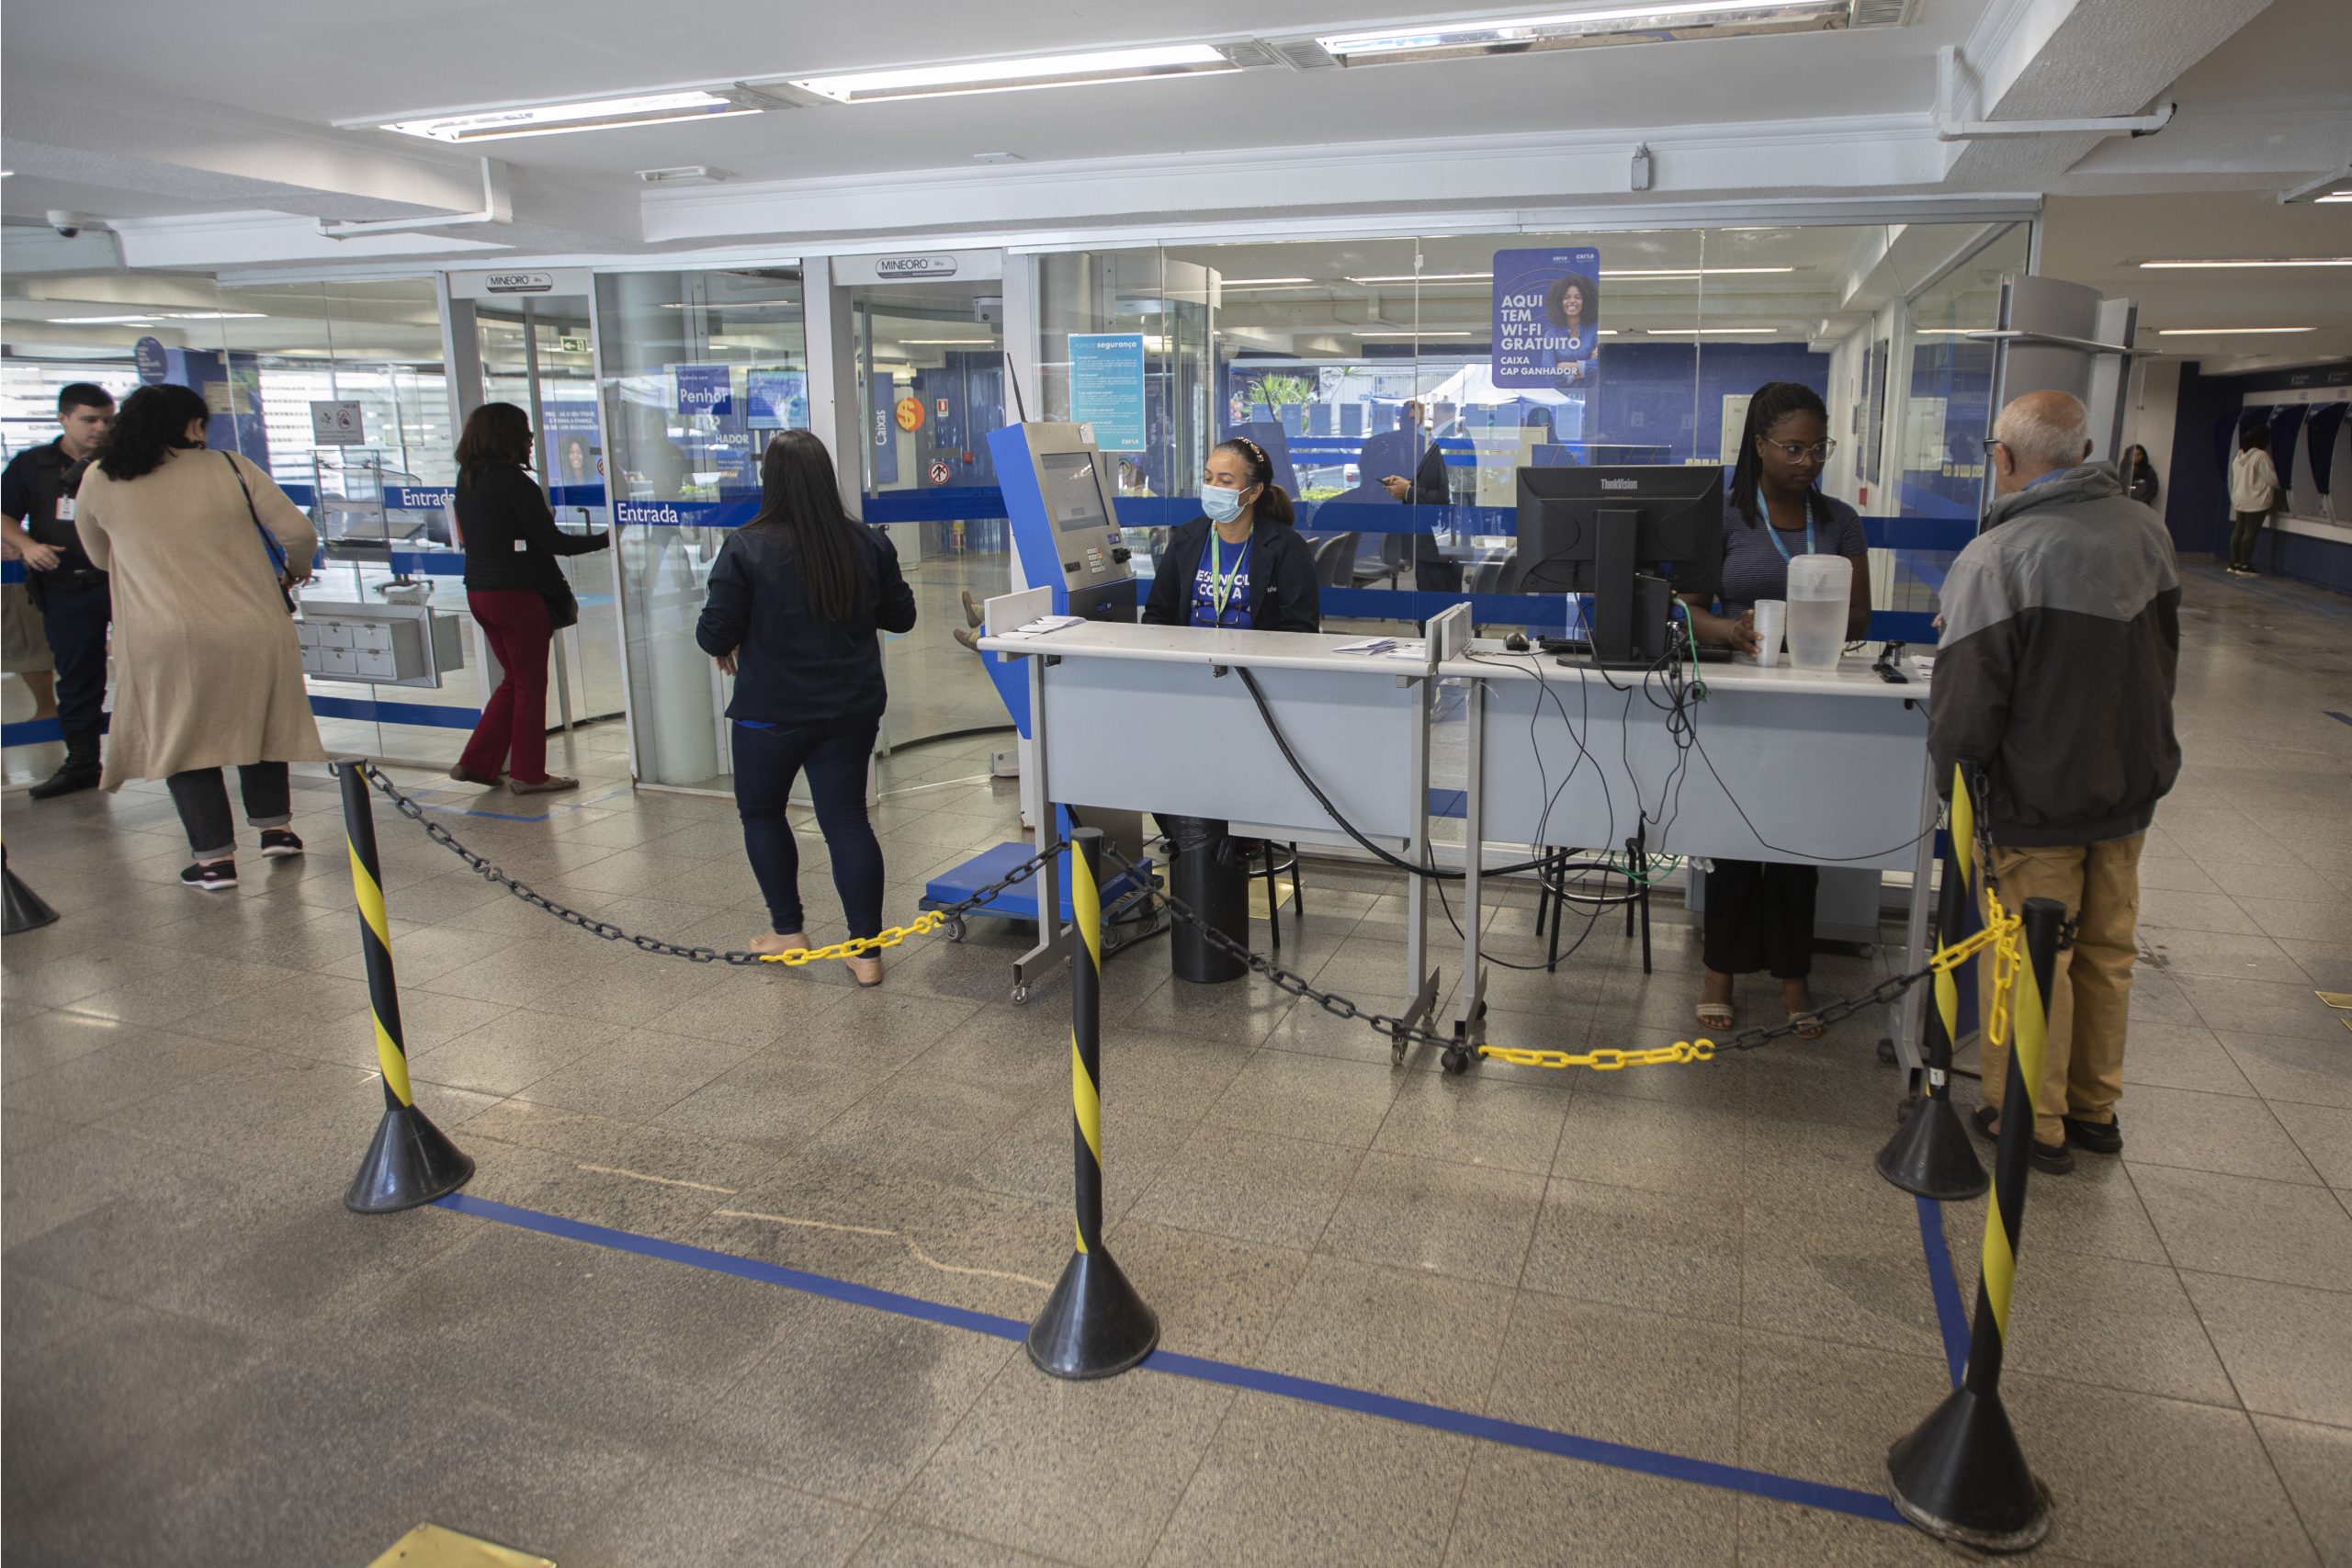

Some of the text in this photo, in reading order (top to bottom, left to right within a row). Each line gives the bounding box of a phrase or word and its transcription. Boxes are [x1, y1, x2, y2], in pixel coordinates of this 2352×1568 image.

[881, 258, 928, 270] MINEORO
[491, 275, 529, 286] MINEORO
[1501, 294, 1543, 308] AQUI
[1500, 309, 1532, 321] TEM
[1500, 323, 1542, 336] WI-FI
[1097, 341, 1137, 350] segurança
[1500, 337, 1581, 350] GRATUITO
[1500, 356, 1530, 365] CAIXA
[1500, 367, 1578, 376] CAP GANHADOR
[680, 387, 729, 403] Penhor
[876, 409, 888, 446] Caixas
[1600, 478, 1638, 490] ThinkVision
[617, 502, 678, 523] Entrada
